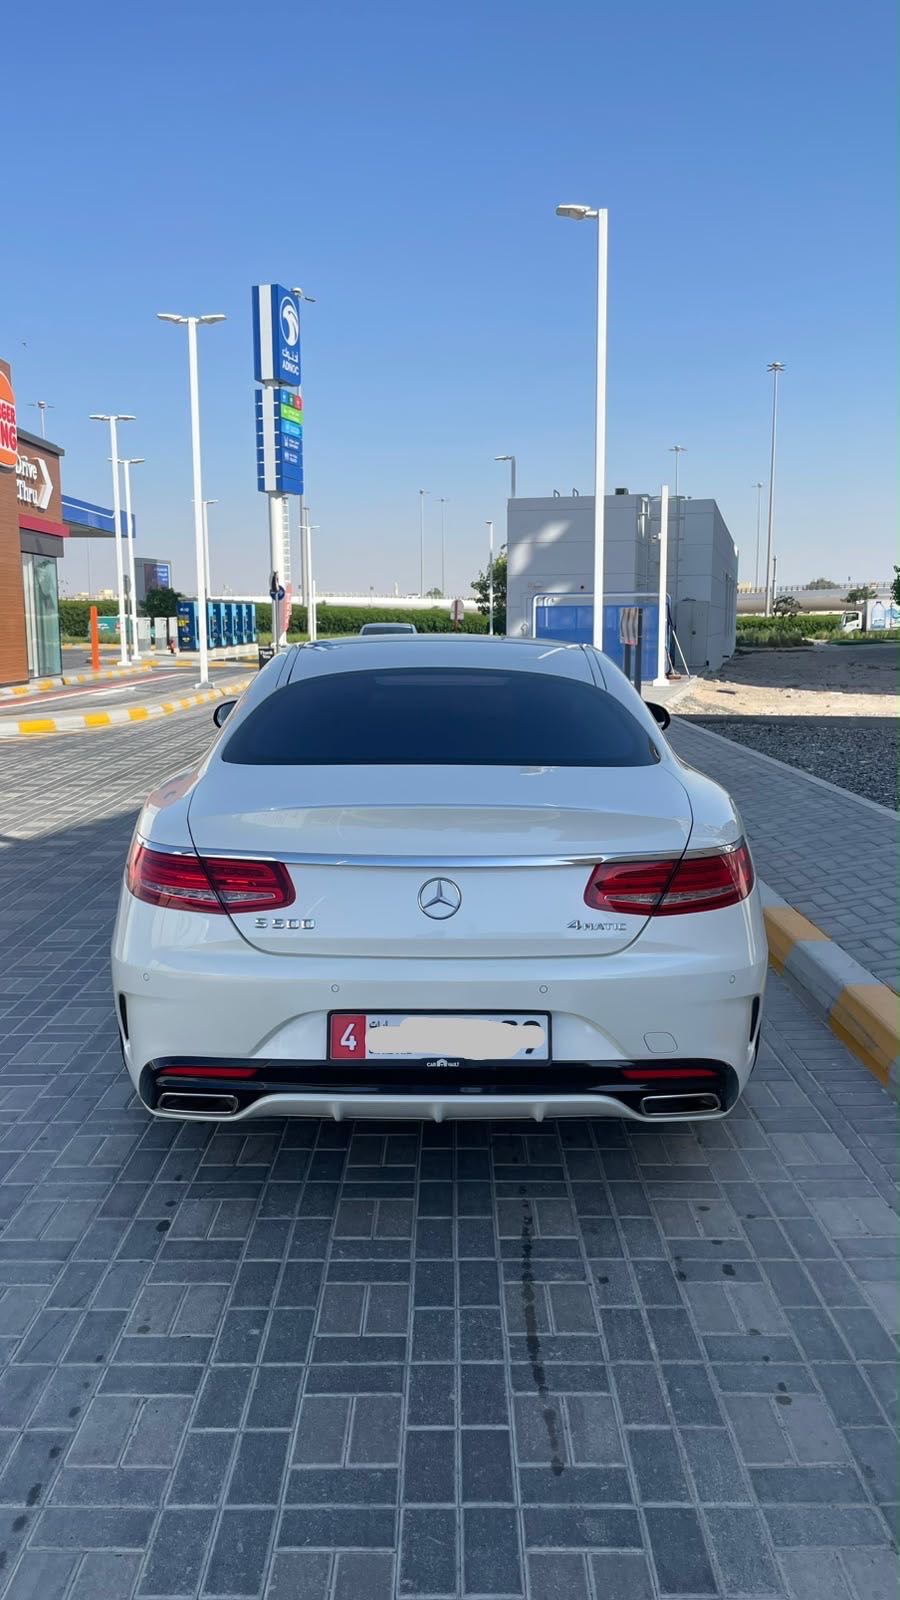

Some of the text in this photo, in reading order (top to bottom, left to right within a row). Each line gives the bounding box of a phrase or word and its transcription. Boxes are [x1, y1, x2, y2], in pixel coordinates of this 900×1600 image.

[282, 360, 299, 375] ADNOC
[16, 455, 38, 480] Drive
[16, 480, 39, 505] Thru
[255, 918, 316, 930] S 500
[567, 919, 627, 931] 4MATIC
[339, 1023, 357, 1052] 4
